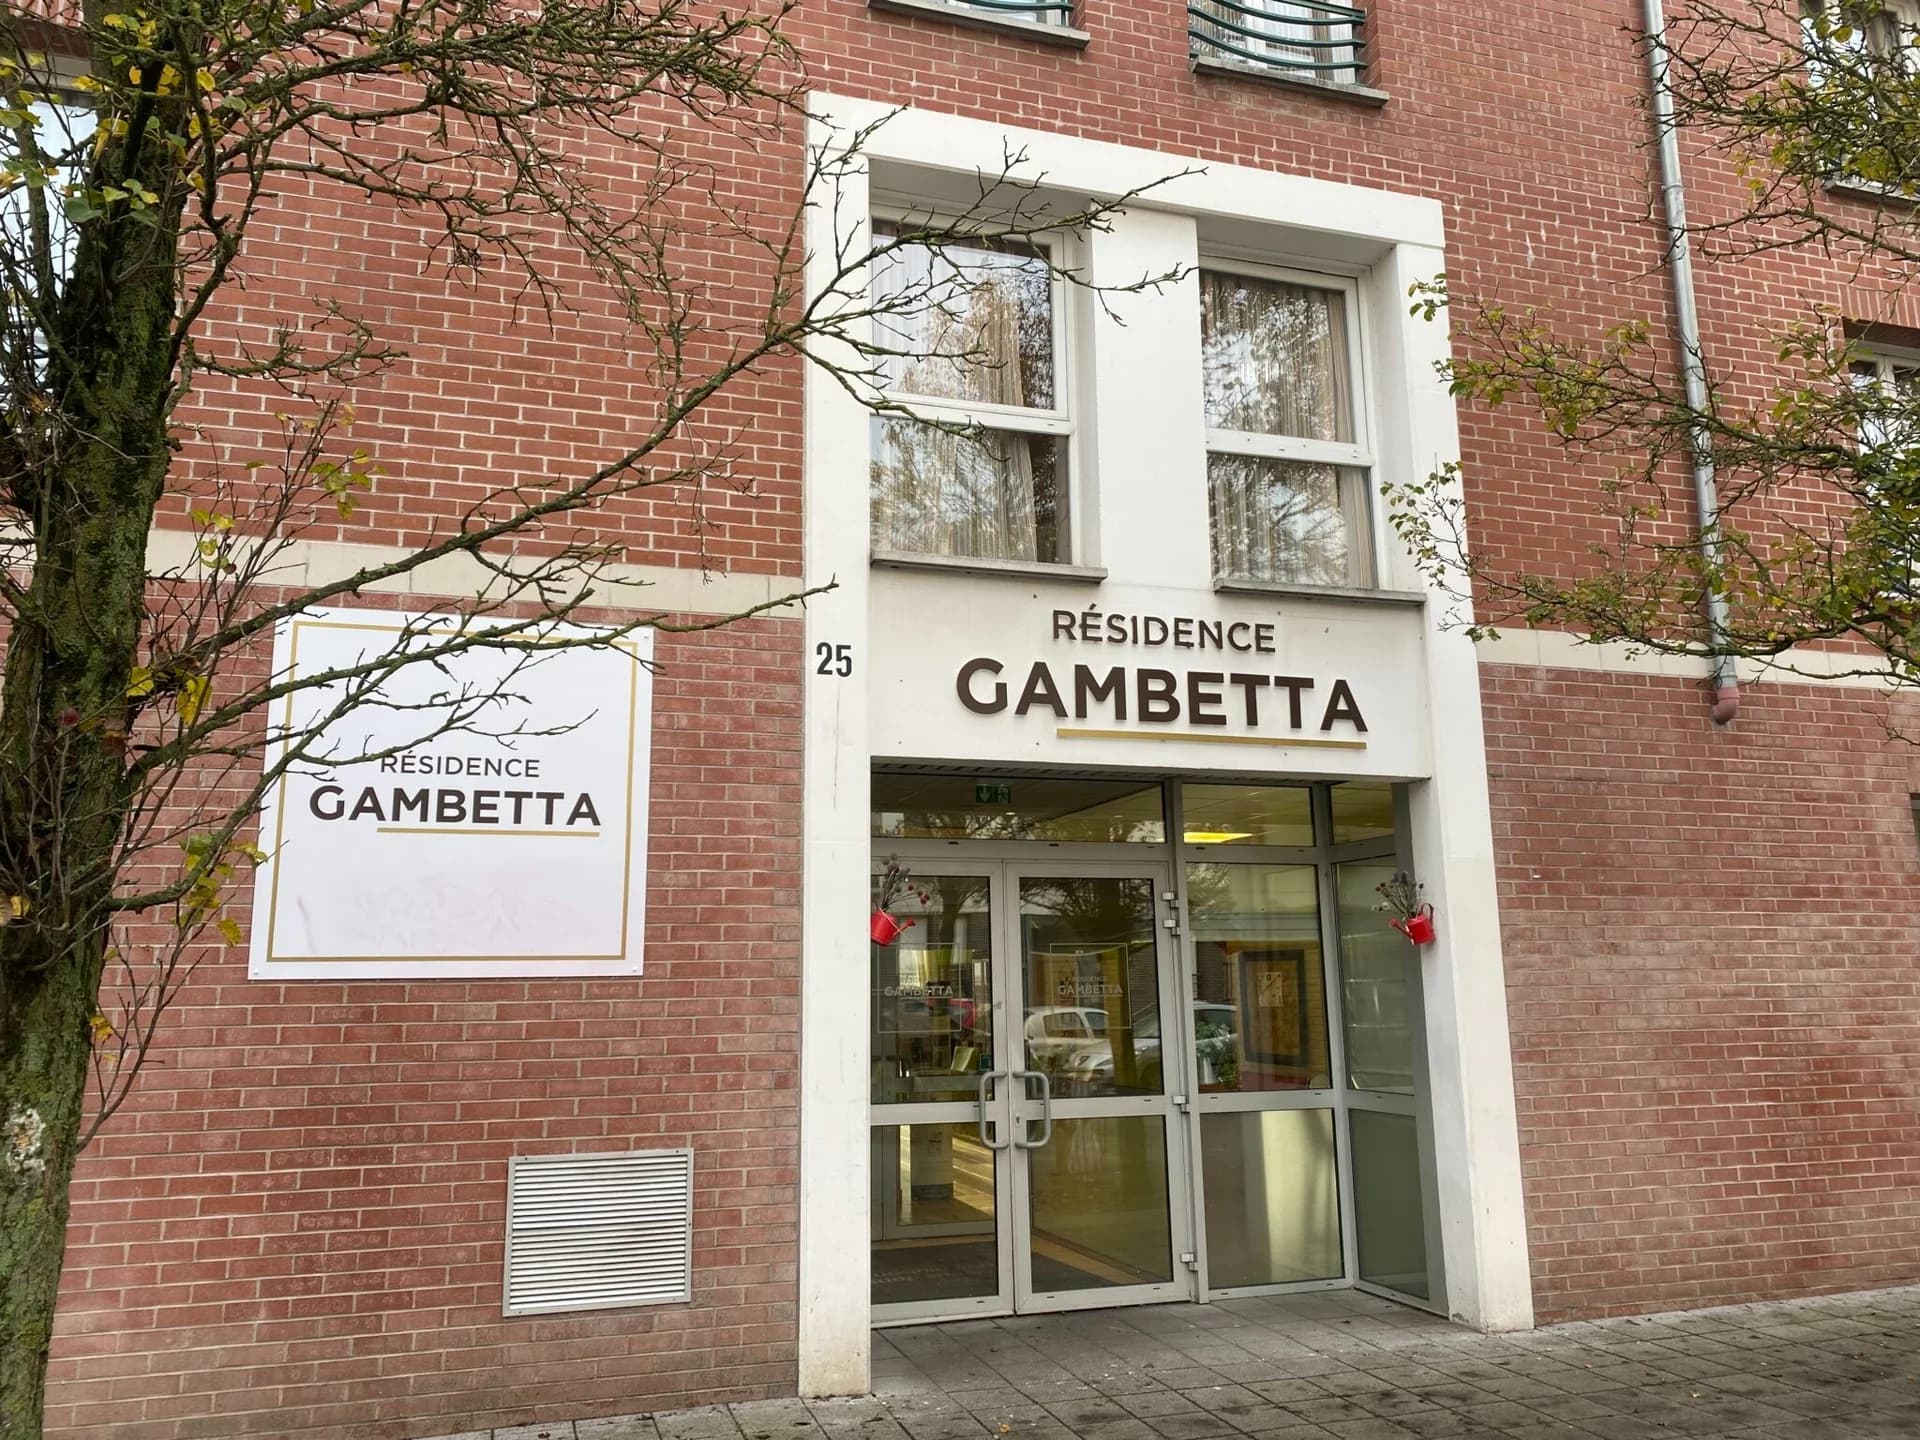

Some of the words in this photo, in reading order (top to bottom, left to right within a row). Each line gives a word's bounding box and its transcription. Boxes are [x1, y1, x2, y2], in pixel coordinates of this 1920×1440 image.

[1052, 604, 1276, 653] RÉSIDENCE
[816, 642, 853, 678] 25
[956, 657, 1368, 732] GAMBETTA
[380, 750, 540, 777] RÉSIDENCE
[309, 785, 601, 826] GAMBETTA
